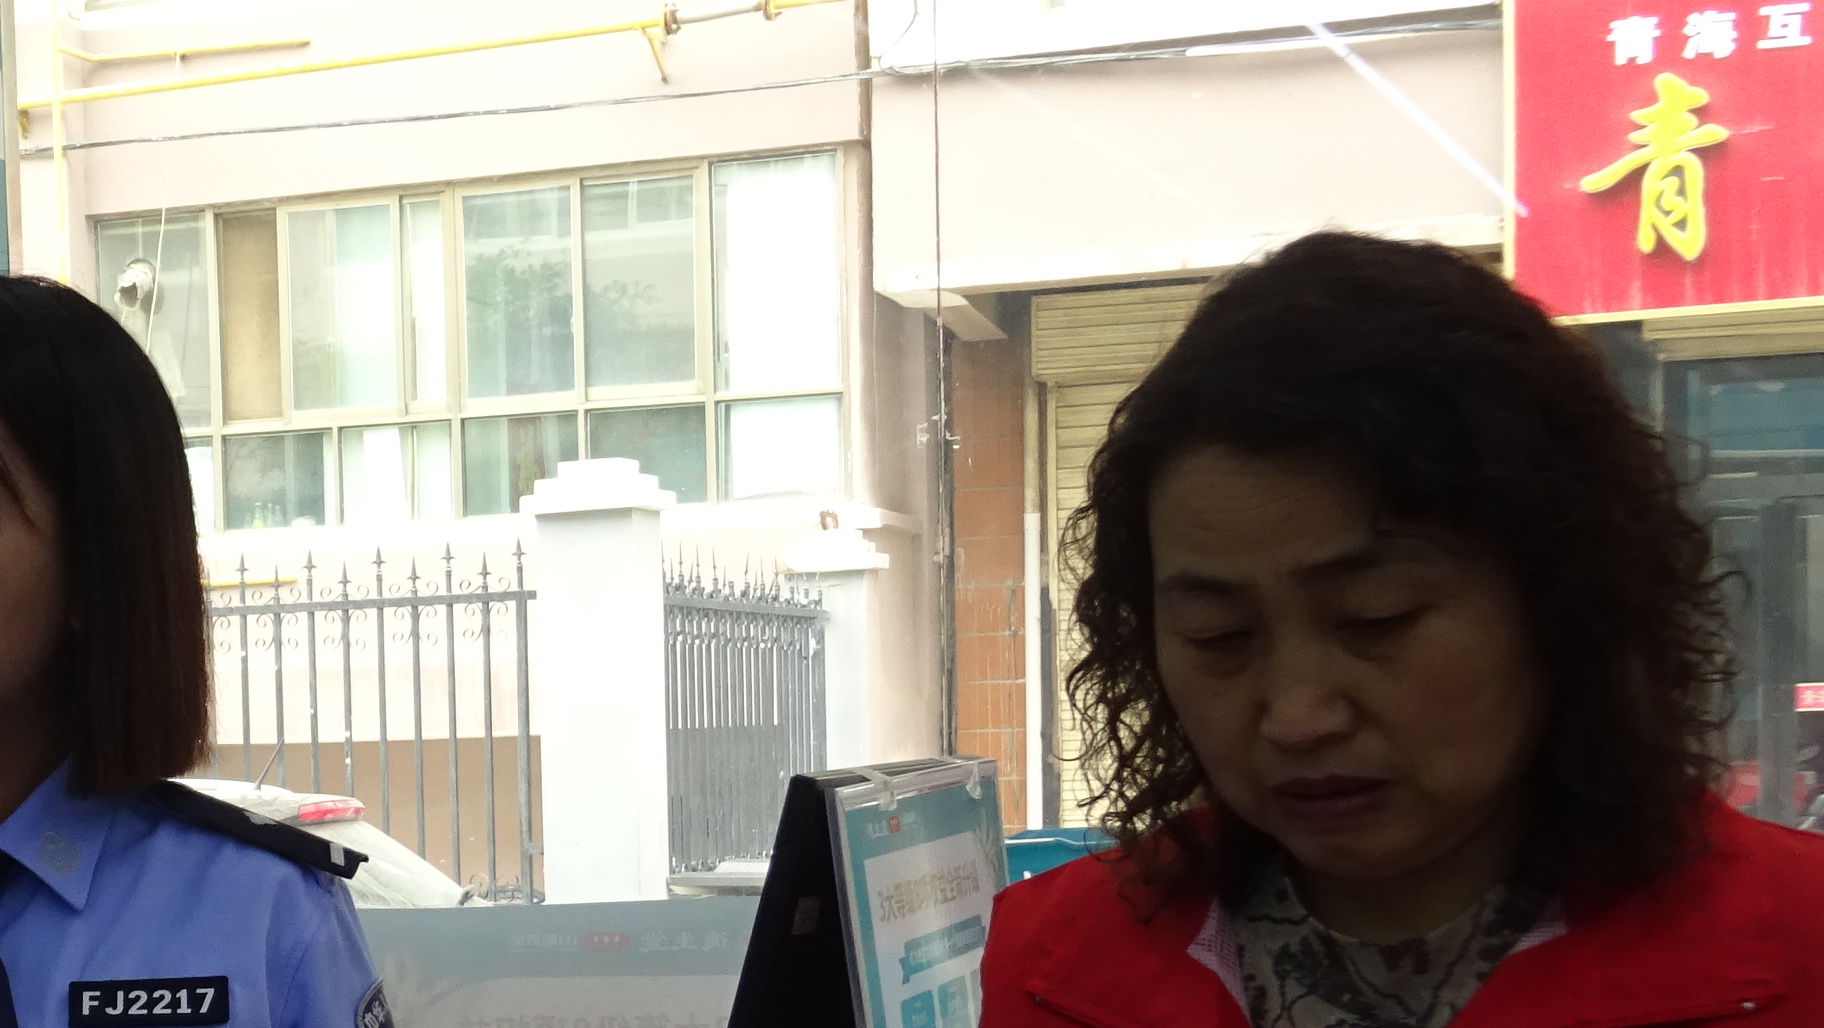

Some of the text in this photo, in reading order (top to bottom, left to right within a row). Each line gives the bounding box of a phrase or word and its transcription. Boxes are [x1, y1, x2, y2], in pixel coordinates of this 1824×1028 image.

[1606, 3, 1812, 65] 青海互
[1580, 72, 1729, 261] 青
[80, 987, 217, 1017] FJ2217
